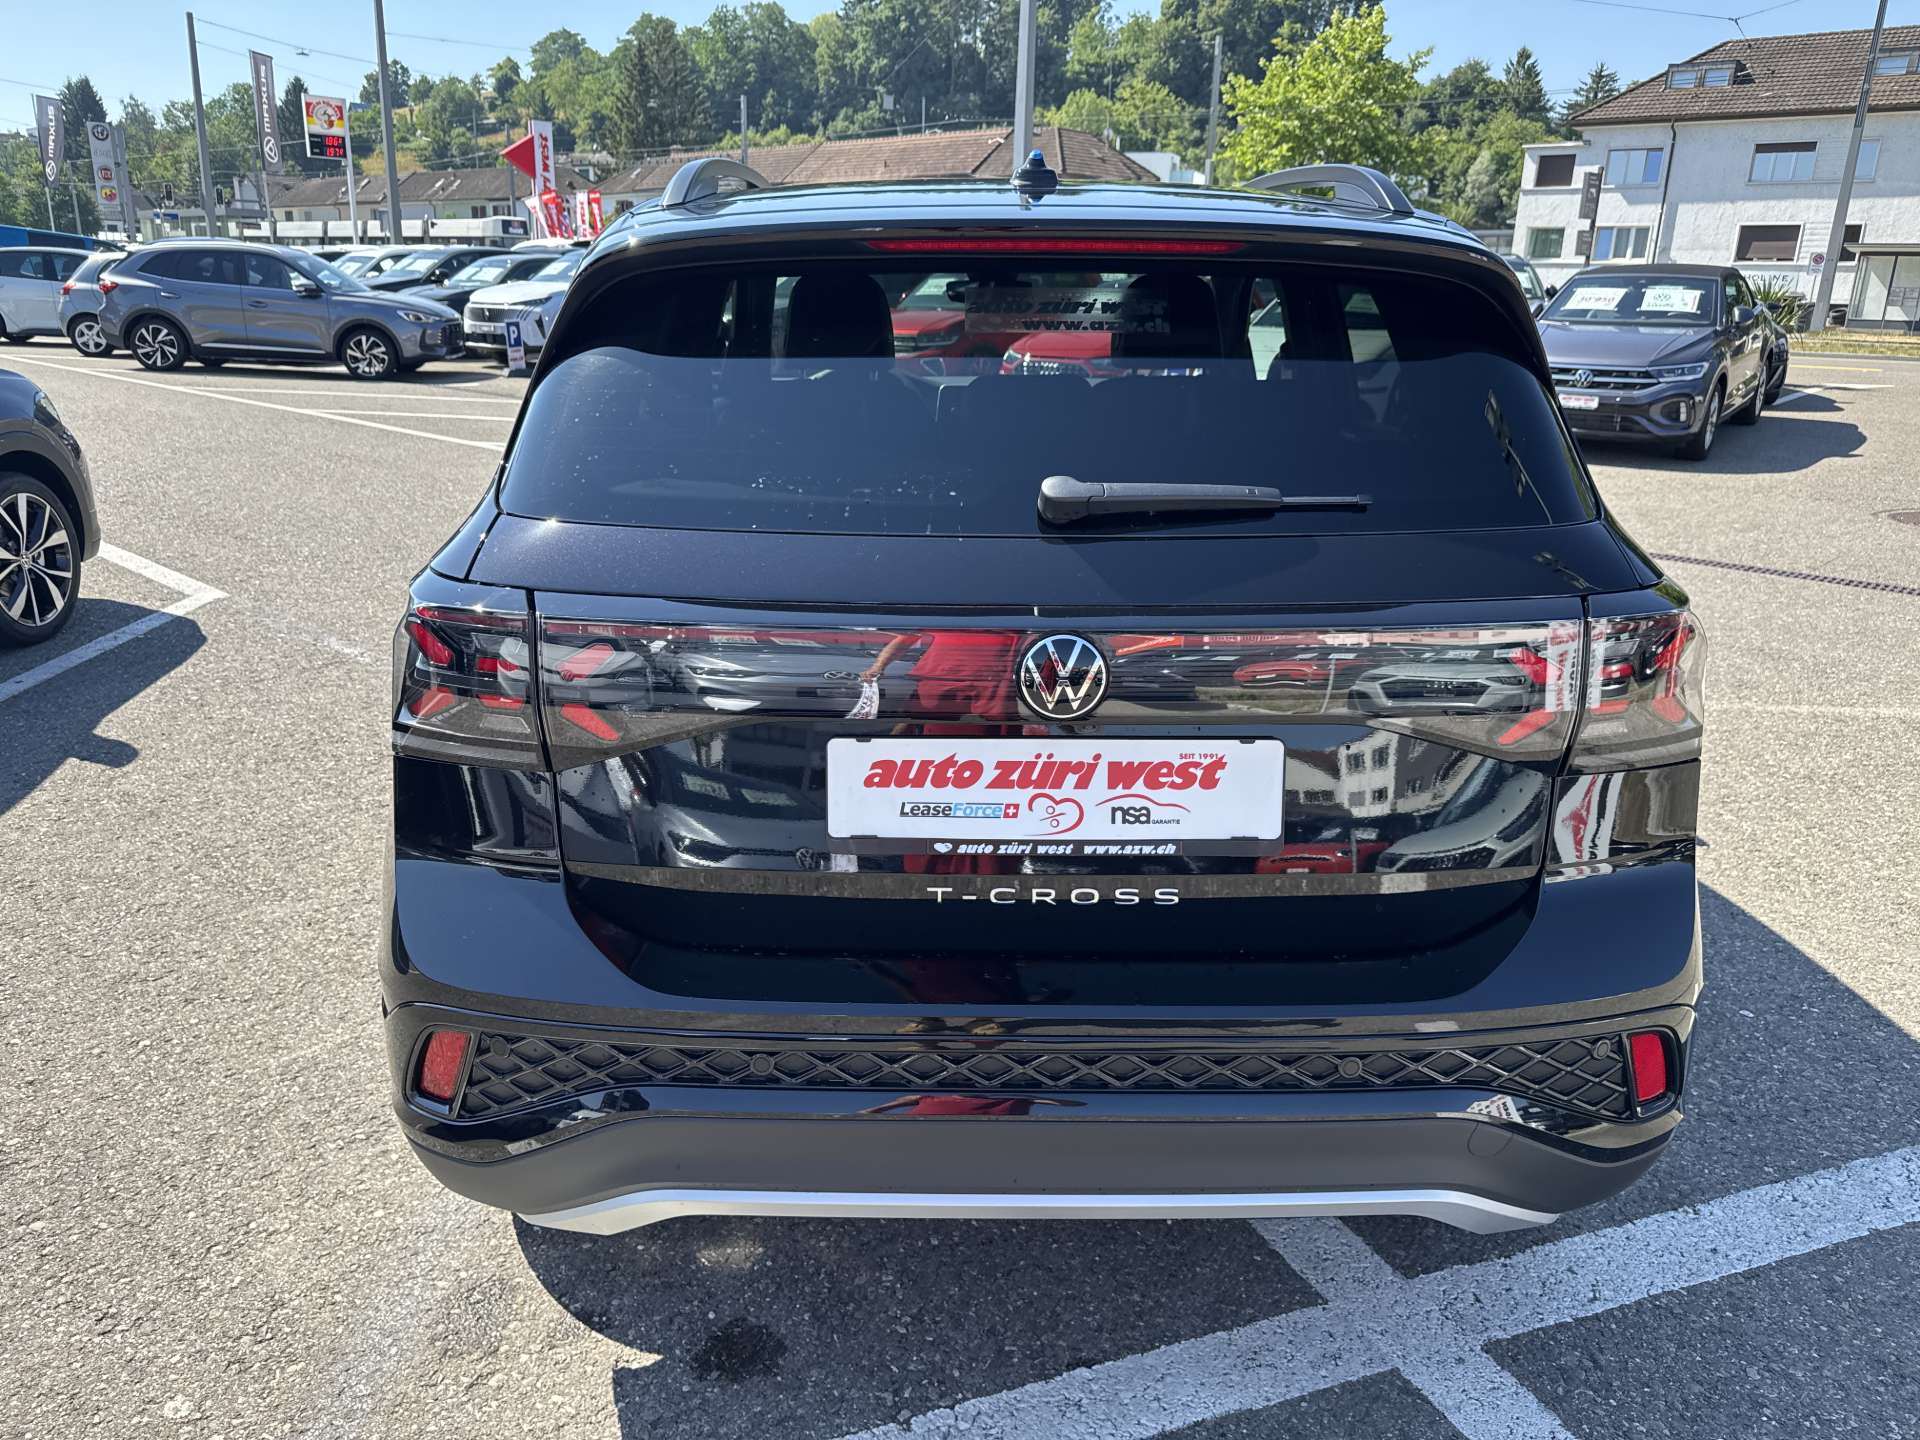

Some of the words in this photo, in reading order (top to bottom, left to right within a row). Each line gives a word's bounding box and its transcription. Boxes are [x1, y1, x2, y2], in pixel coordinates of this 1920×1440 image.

[260, 64, 272, 133] MAXUS
[47, 105, 56, 158] MAXUS
[509, 325, 518, 345] P
[863, 752, 984, 789] auto
[984, 752, 1102, 790] züri
[1107, 754, 1228, 791] west
[900, 801, 1003, 817] LeaseForce
[1110, 806, 1151, 825] nsa
[957, 843, 994, 854] auto
[997, 841, 1031, 854] züri
[1036, 842, 1073, 854] west
[1083, 842, 1177, 855] www.azw.ch
[927, 886, 1180, 906] T-CROSS
